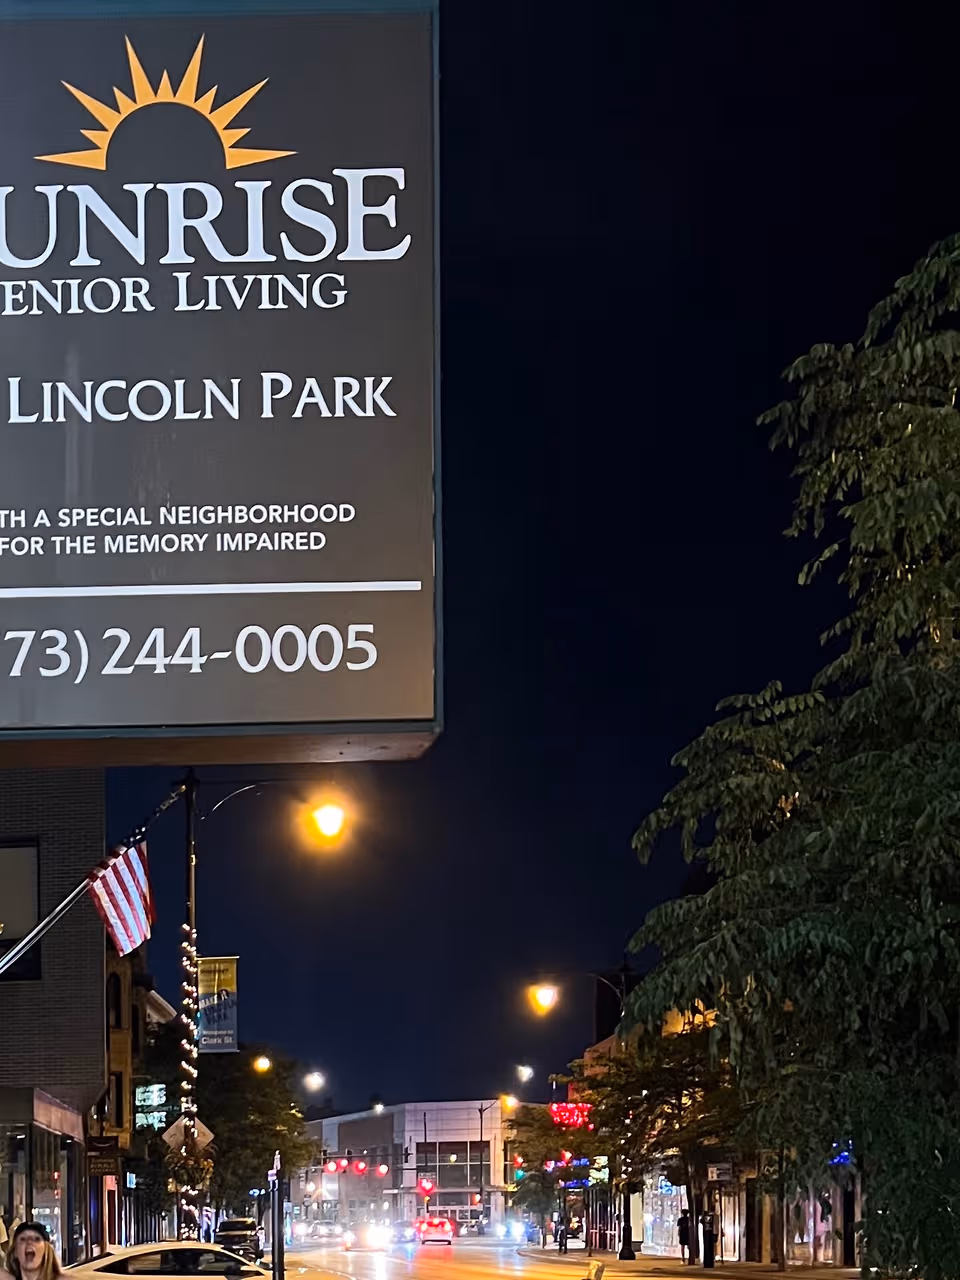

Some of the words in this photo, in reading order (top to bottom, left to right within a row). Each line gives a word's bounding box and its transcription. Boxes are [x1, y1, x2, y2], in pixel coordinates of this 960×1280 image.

[172, 272, 348, 312] LIVING
[7, 376, 242, 424] LINCOLN
[260, 372, 398, 419] PARK
[33, 509, 51, 528] A
[58, 506, 153, 527] SPECIAL
[159, 502, 356, 525] NEIGHBORHOOD
[50, 535, 96, 555] THE
[104, 533, 209, 554] MEMORY
[216, 531, 327, 552] IMPAIRED
[100, 623, 378, 675] 244-0005
[201, 1036, 222, 1044] Clark
[224, 1036, 233, 1044] St
